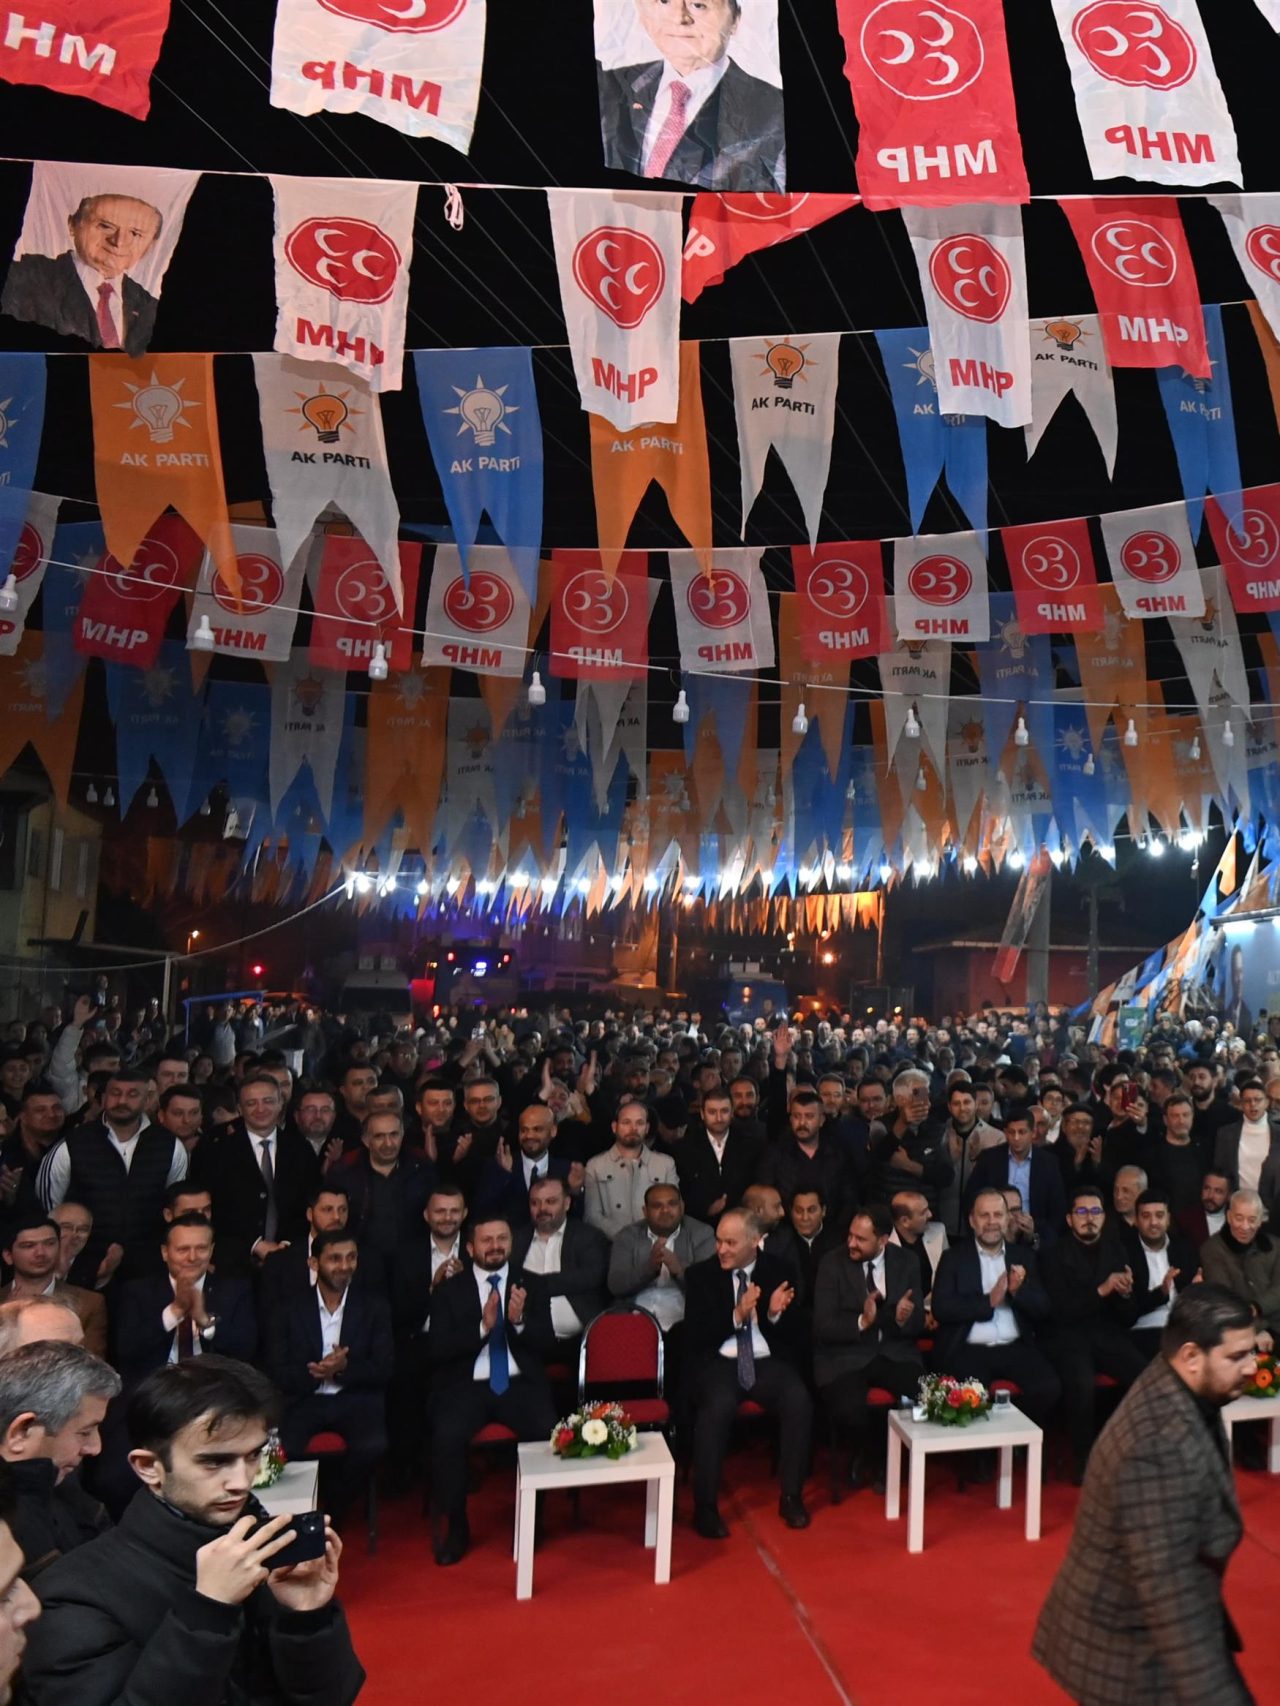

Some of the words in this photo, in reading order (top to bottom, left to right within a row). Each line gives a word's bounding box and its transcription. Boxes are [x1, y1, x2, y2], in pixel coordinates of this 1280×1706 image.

[1118, 314, 1189, 348] MHP
[1035, 353, 1055, 362] AK
[591, 356, 659, 404] MHP
[948, 357, 1014, 399] MHP
[752, 397, 770, 410] AK
[913, 404, 935, 415] AK
[1180, 400, 1196, 412] AK
[610, 439, 635, 453] AK
[121, 452, 149, 466] AK
[291, 451, 317, 464] AK
[450, 457, 474, 474] AK
[81, 616, 149, 649] MHP
